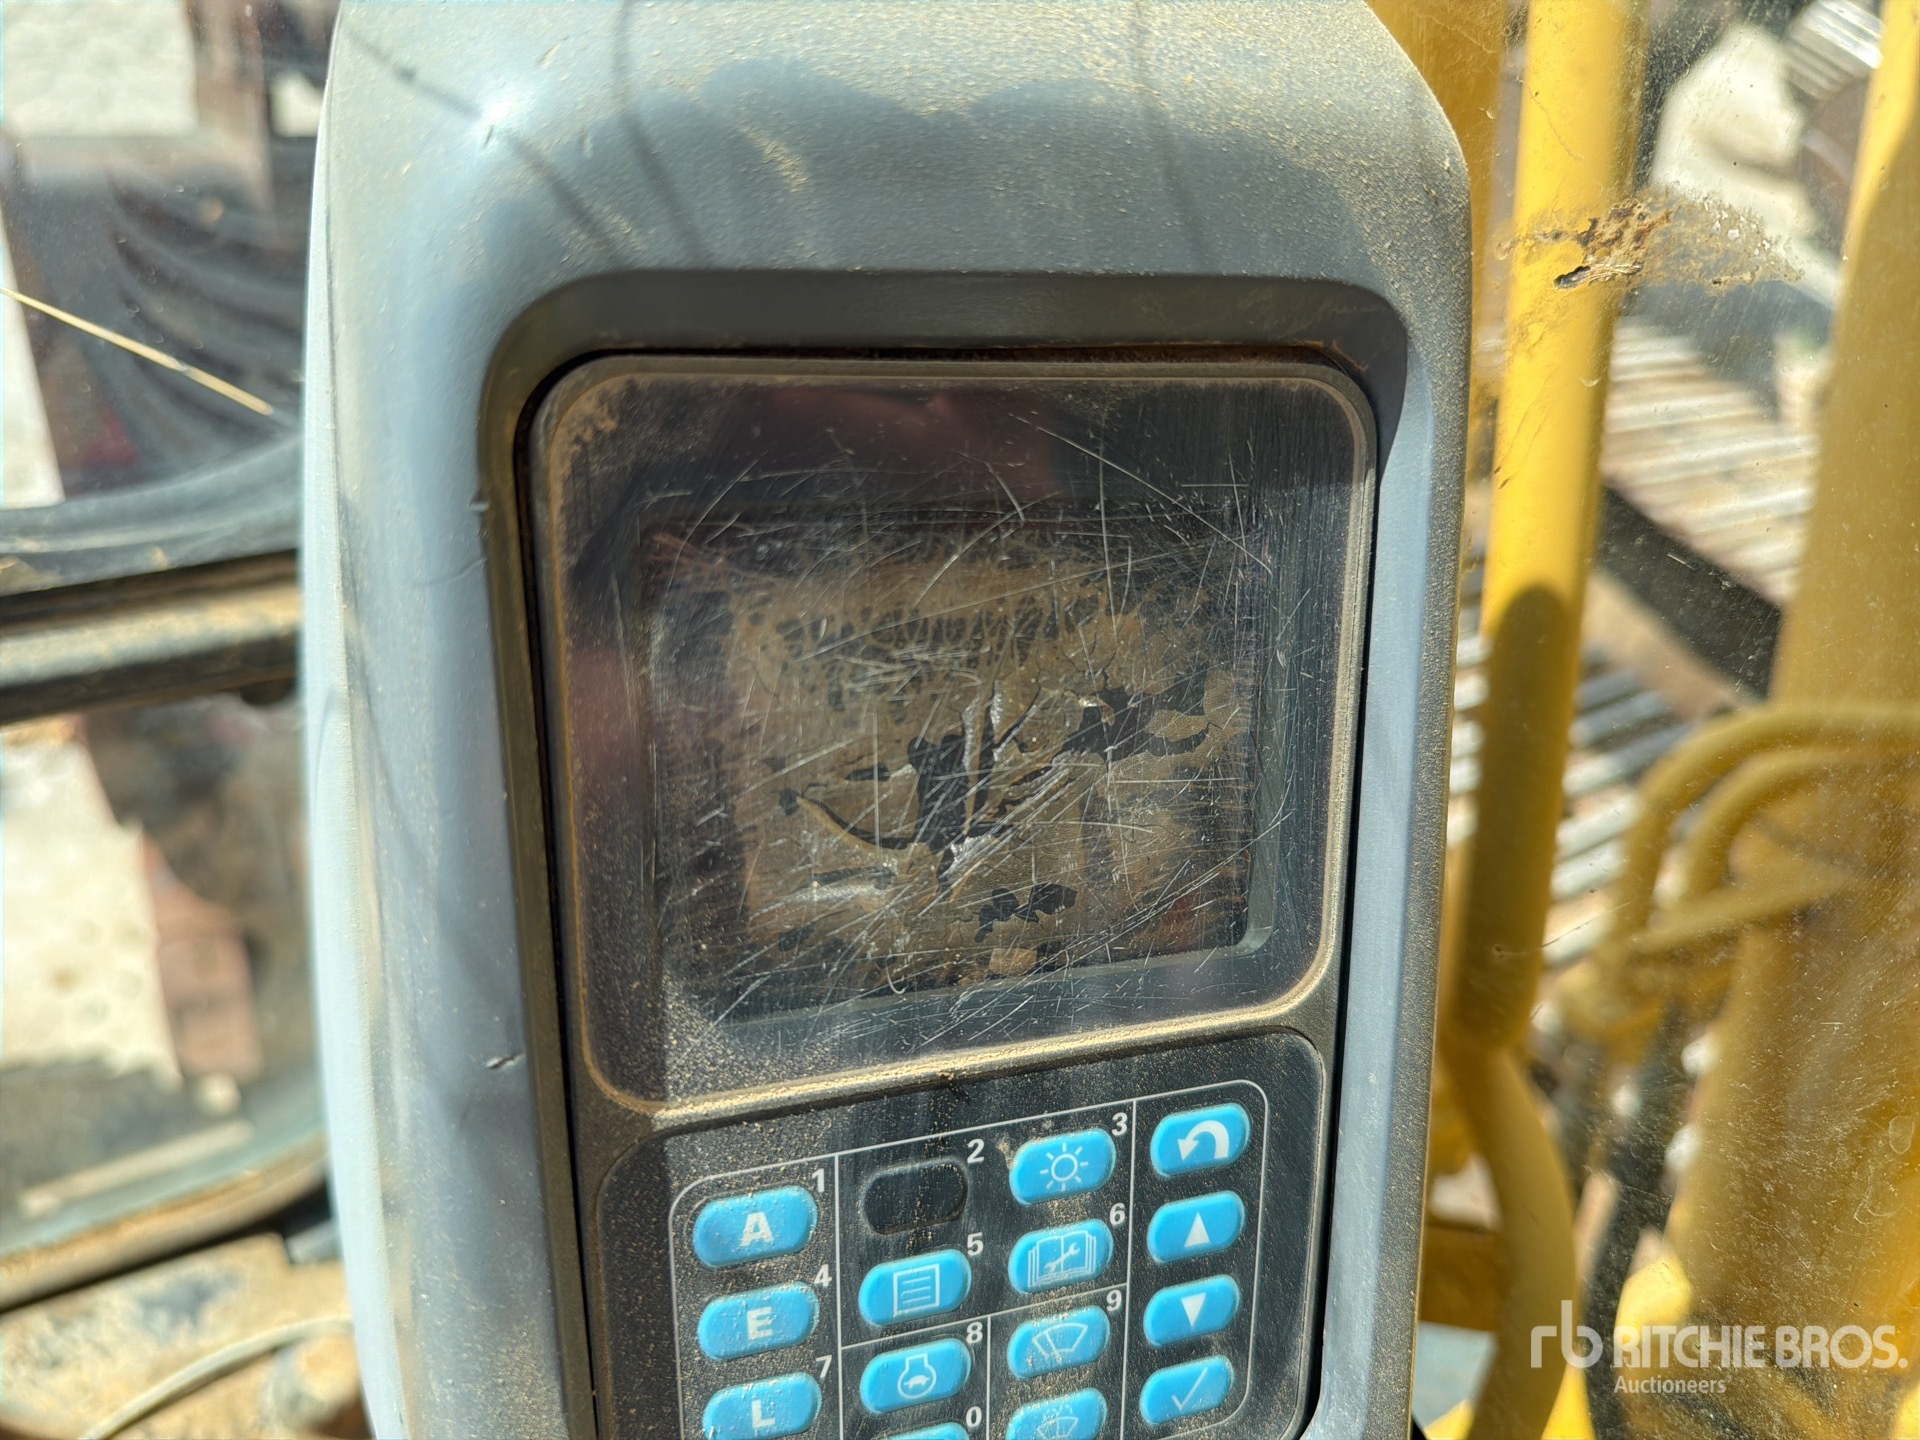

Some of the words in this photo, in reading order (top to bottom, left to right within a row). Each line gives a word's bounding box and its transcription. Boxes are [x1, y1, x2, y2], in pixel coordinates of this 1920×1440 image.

[1111, 1112, 1128, 1136] 3
[966, 1139, 986, 1164] 2
[811, 1169, 826, 1193] 1
[1109, 1203, 1126, 1226] 6
[739, 1211, 775, 1248] A
[966, 1232, 984, 1256] 5
[813, 1264, 833, 1289] 4
[1106, 1289, 1123, 1313] 9
[746, 1306, 773, 1341] E
[965, 1322, 983, 1345] 8
[815, 1355, 832, 1379] 7
[751, 1397, 776, 1430] L
[965, 1406, 982, 1430] 0
